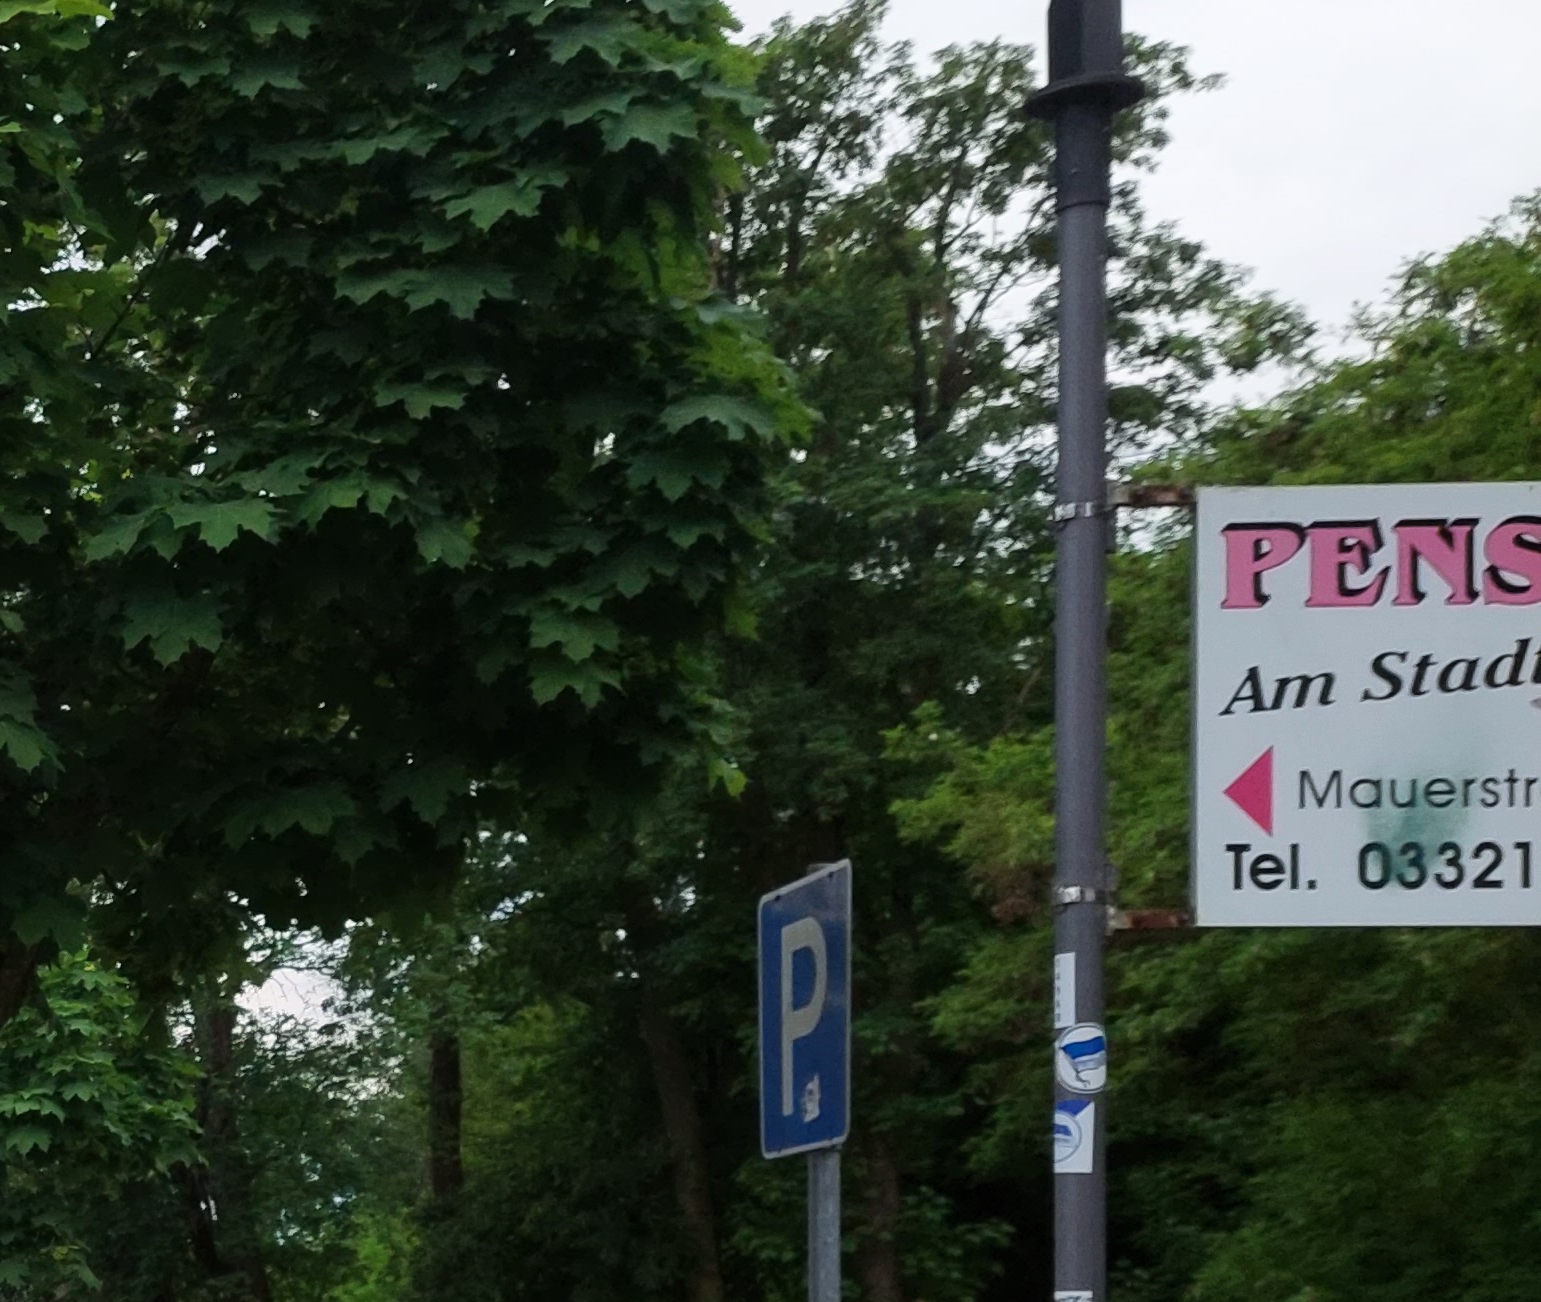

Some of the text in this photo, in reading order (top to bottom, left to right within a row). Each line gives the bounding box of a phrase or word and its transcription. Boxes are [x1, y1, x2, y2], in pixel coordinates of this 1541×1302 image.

[1220, 515, 1541, 609] PENS
[1218, 665, 1337, 717] Am
[1297, 768, 1538, 810] Mauerstr
[1225, 841, 1532, 891] Tel. 03321
[781, 916, 827, 1117] P
